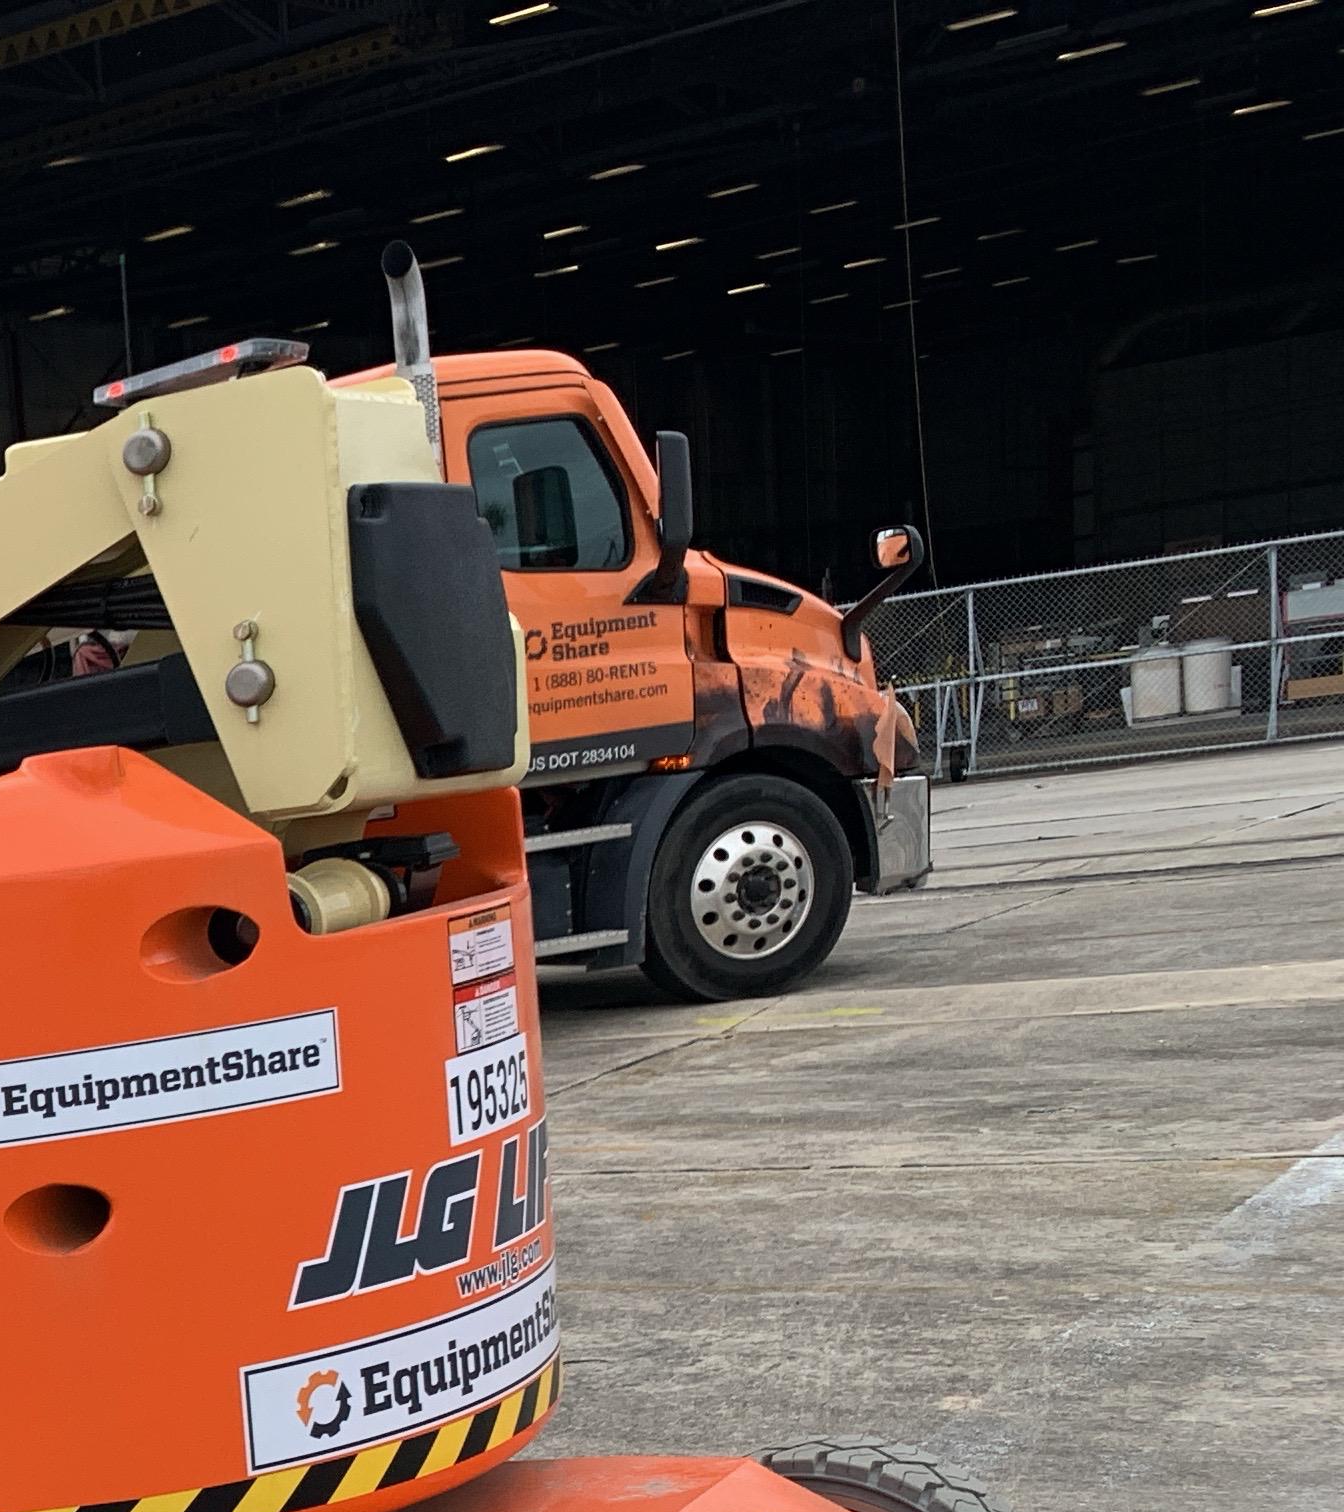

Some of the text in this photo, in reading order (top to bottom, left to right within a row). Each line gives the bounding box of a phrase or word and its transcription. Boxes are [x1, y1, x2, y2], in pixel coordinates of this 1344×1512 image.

[551, 611, 657, 642] Equipment
[552, 641, 610, 662] Share
[533, 661, 657, 692] 1 (888) 80-RENTS
[548, 751, 580, 771] DOT
[581, 744, 636, 766] 2834104
[450, 1050, 528, 1136] 195325
[289, 1150, 482, 1310] JLG
[458, 1239, 542, 1297] www.jlg.com
